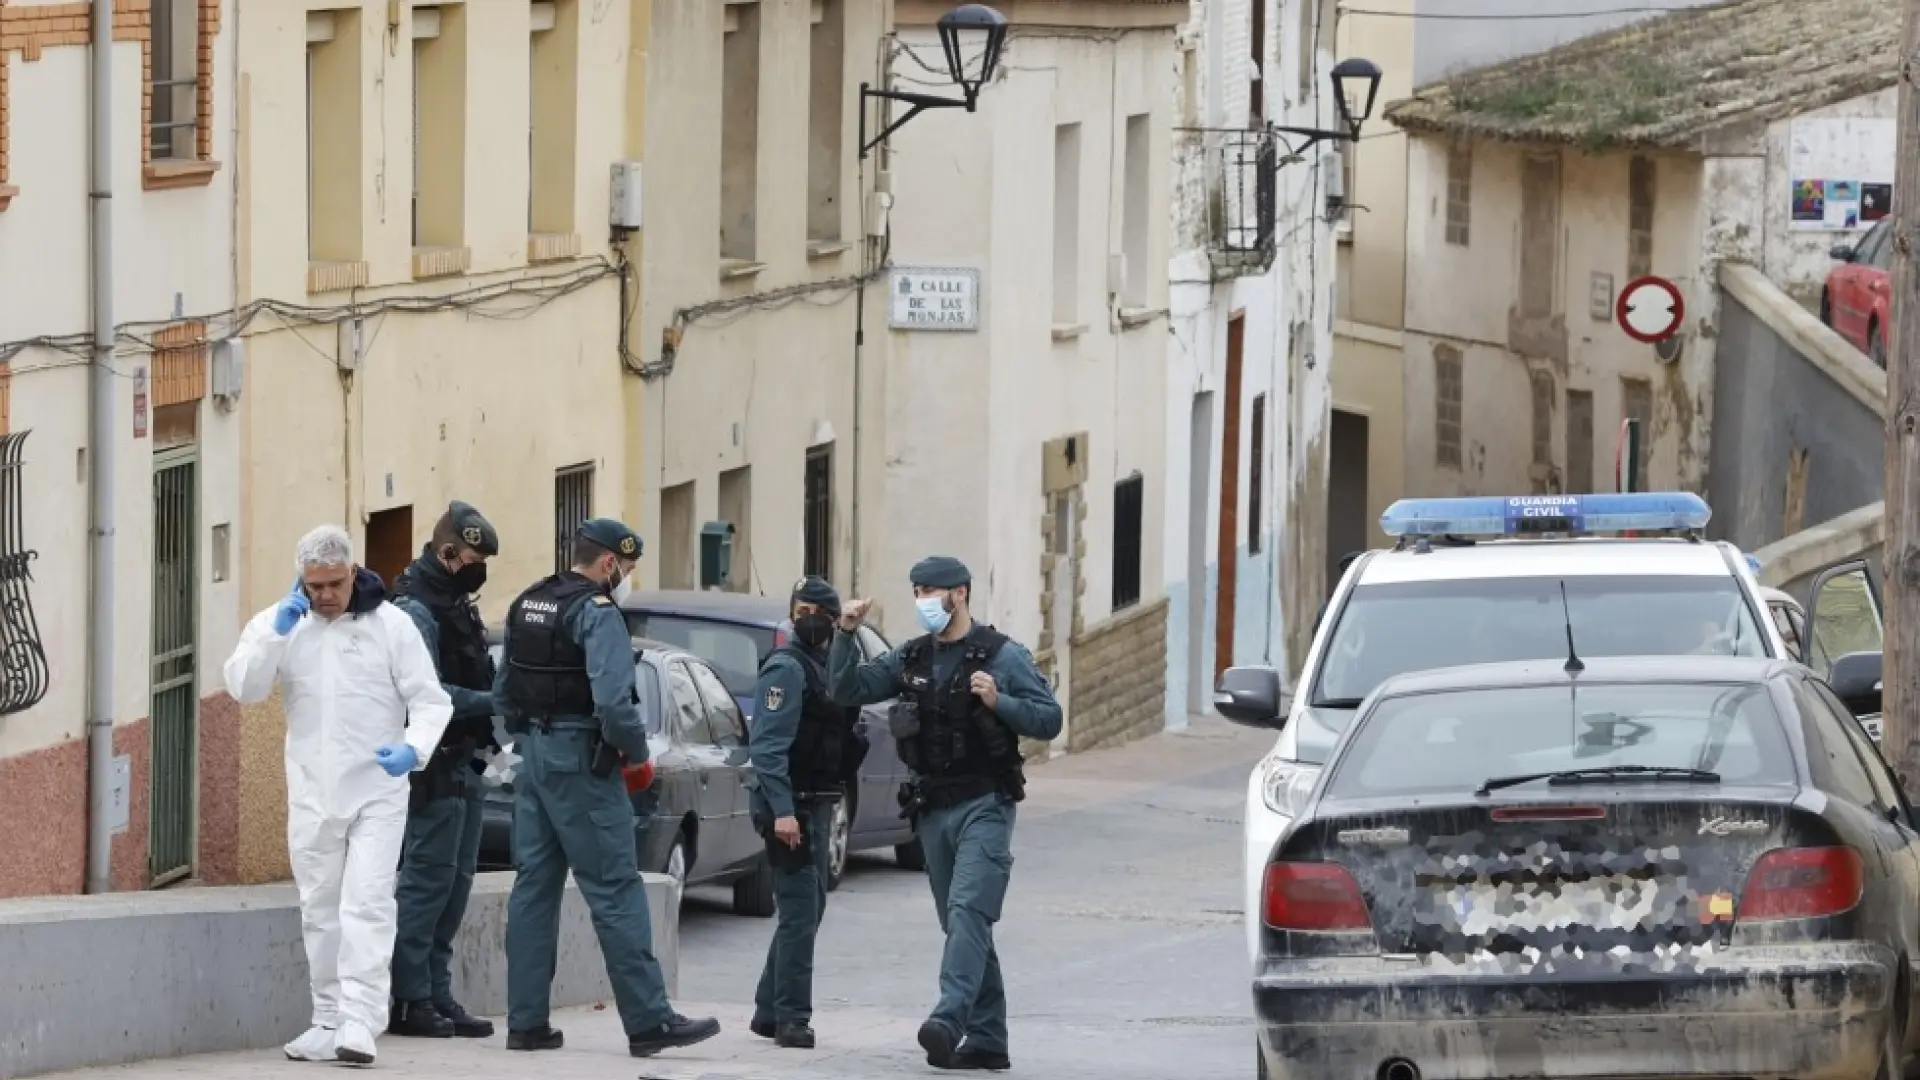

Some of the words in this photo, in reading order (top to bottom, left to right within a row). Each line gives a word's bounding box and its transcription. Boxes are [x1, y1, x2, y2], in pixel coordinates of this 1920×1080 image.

[921, 281, 963, 293] CALLE
[909, 298, 926, 309] DE
[941, 298, 962, 309] LAS
[908, 311, 966, 322] MONJAS
[1509, 497, 1578, 507] GUARDIA
[1523, 507, 1564, 517] CIVIL
[521, 599, 558, 613] GUARDIA
[525, 611, 546, 624] CIVIL
